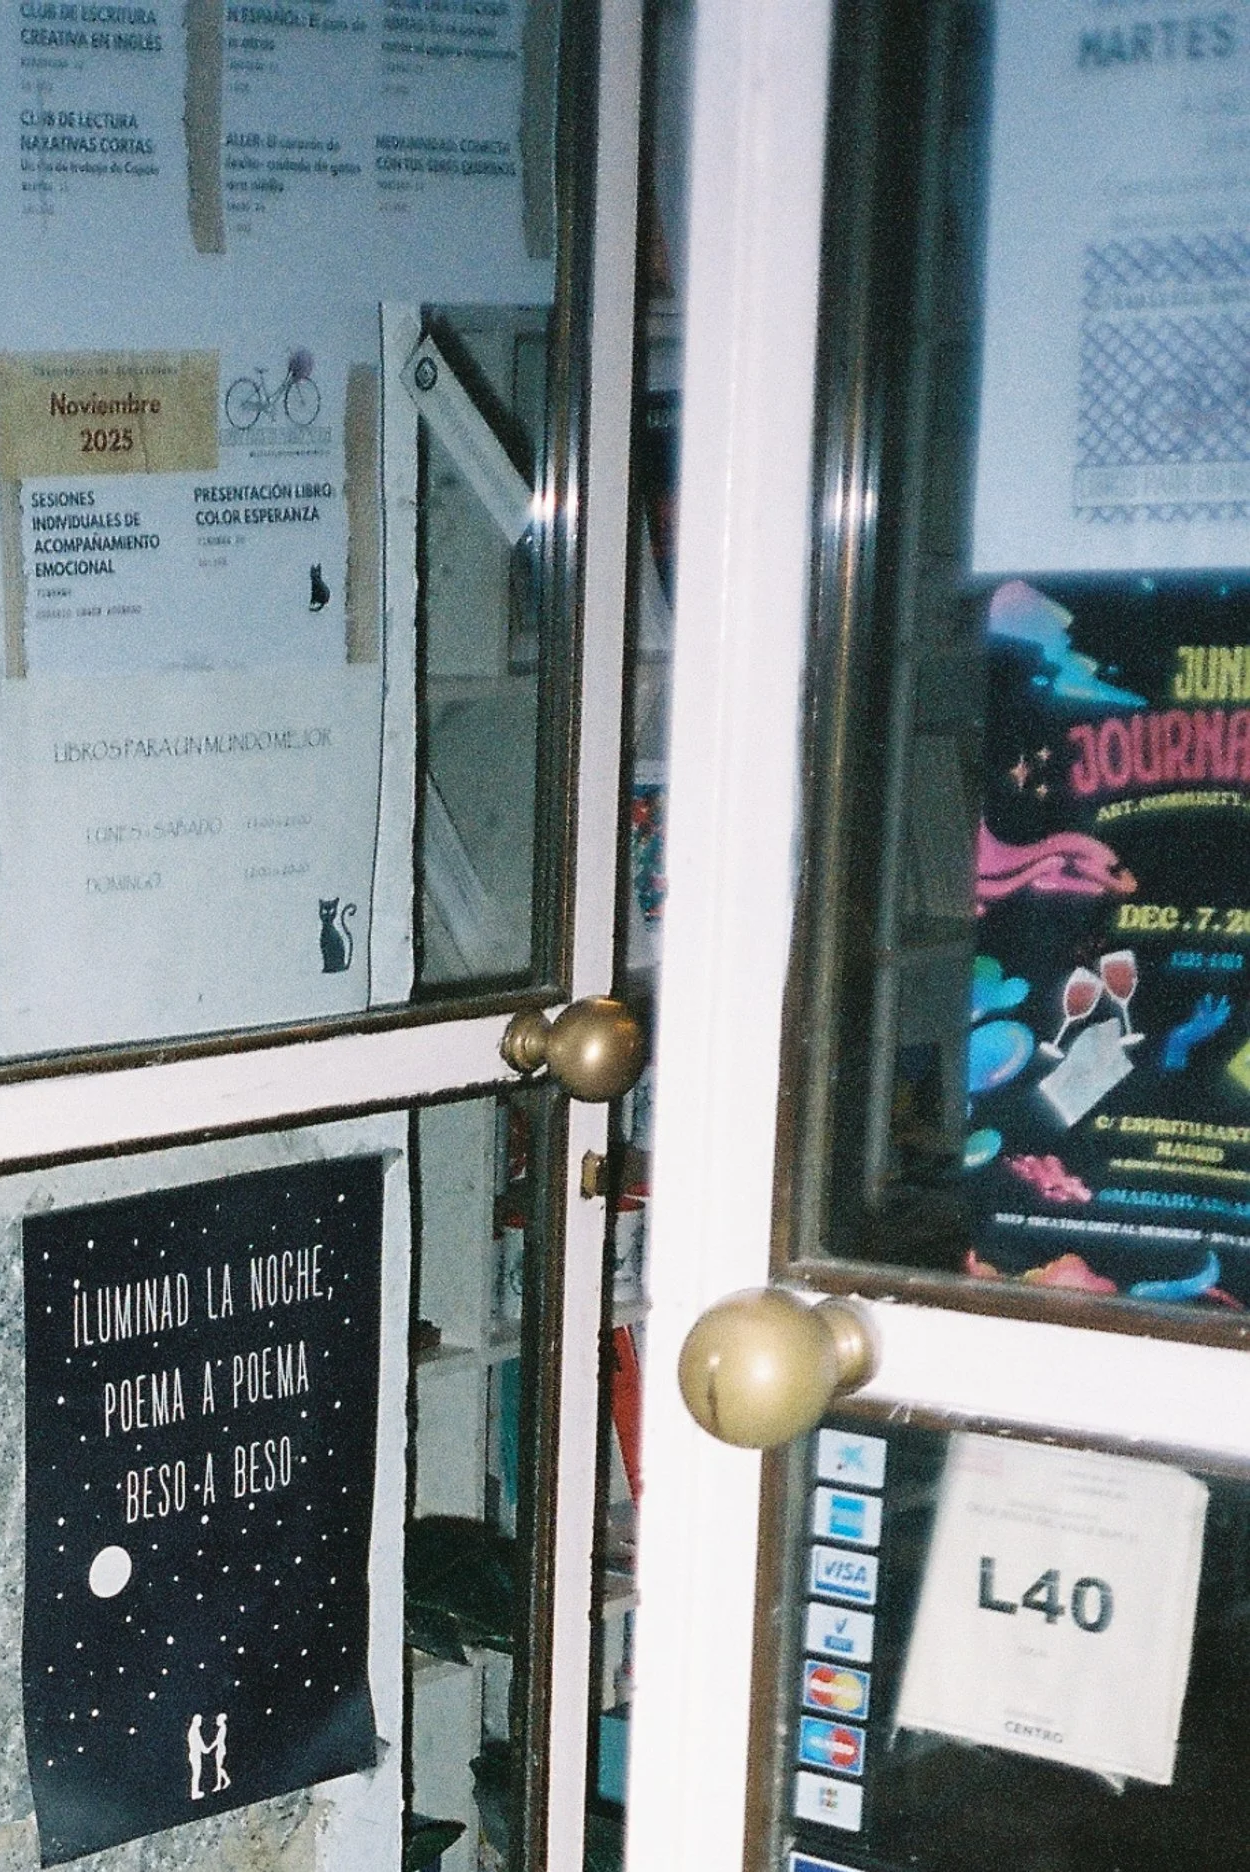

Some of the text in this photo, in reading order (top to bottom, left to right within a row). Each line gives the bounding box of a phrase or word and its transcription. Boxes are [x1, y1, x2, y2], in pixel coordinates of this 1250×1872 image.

[1077, 12, 1237, 69] MARTES
[79, 112, 139, 129] LECTURA
[49, 392, 162, 417] Noviembre
[80, 428, 134, 452] 2025
[31, 491, 95, 507] SESIONES
[295, 482, 332, 498] LIBRO
[32, 513, 141, 532] INDIVIDUALES DE
[196, 506, 320, 526] COLOR ESPERANZA
[34, 532, 161, 553] ACOMPAÑAMIENTO
[36, 560, 116, 577] EMOCIONAL
[54, 740, 122, 763] LIBROS
[124, 738, 172, 760] PARA
[204, 731, 271, 754] MUNDO
[273, 728, 333, 749] MEJOR
[1156, 1141, 1224, 1163] MADRID
[207, 1264, 233, 1320] LA
[251, 1245, 334, 1311] NOCHE,
[104, 1340, 309, 1438] POEMA A POEMA
[126, 1435, 292, 1524] BESO A BESO
[824, 1561, 868, 1586] VISA
[978, 1555, 1114, 1634] L40
[1004, 1720, 1065, 1745] CENTRO
